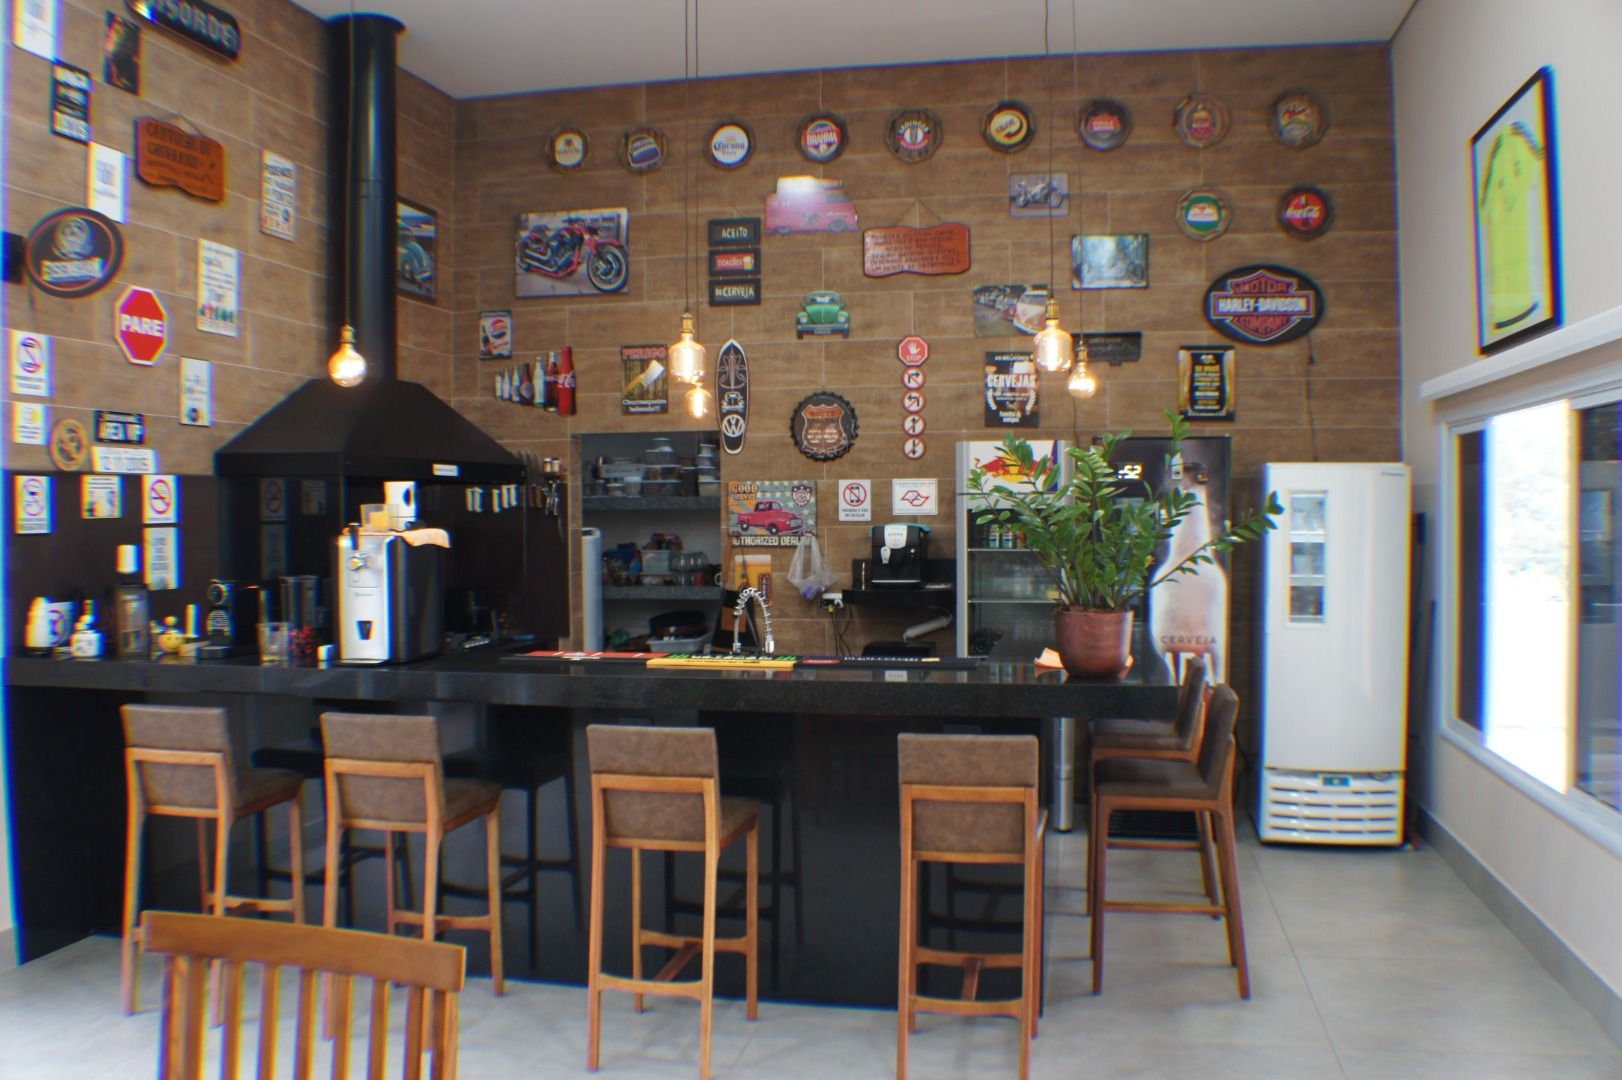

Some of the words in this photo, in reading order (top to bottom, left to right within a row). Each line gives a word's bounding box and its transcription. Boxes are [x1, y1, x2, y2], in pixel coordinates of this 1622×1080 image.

[806, 132, 838, 145] BRAHMA
[714, 141, 745, 151] Corona
[721, 227, 748, 238] ACEITO
[722, 287, 754, 297] CERVEJA
[1238, 282, 1288, 293] MOTOR
[121, 313, 164, 337] PARE
[987, 374, 1036, 387] CERVEJAS
[731, 484, 758, 493] GOOD
[1160, 635, 1217, 645] CERVEJA
